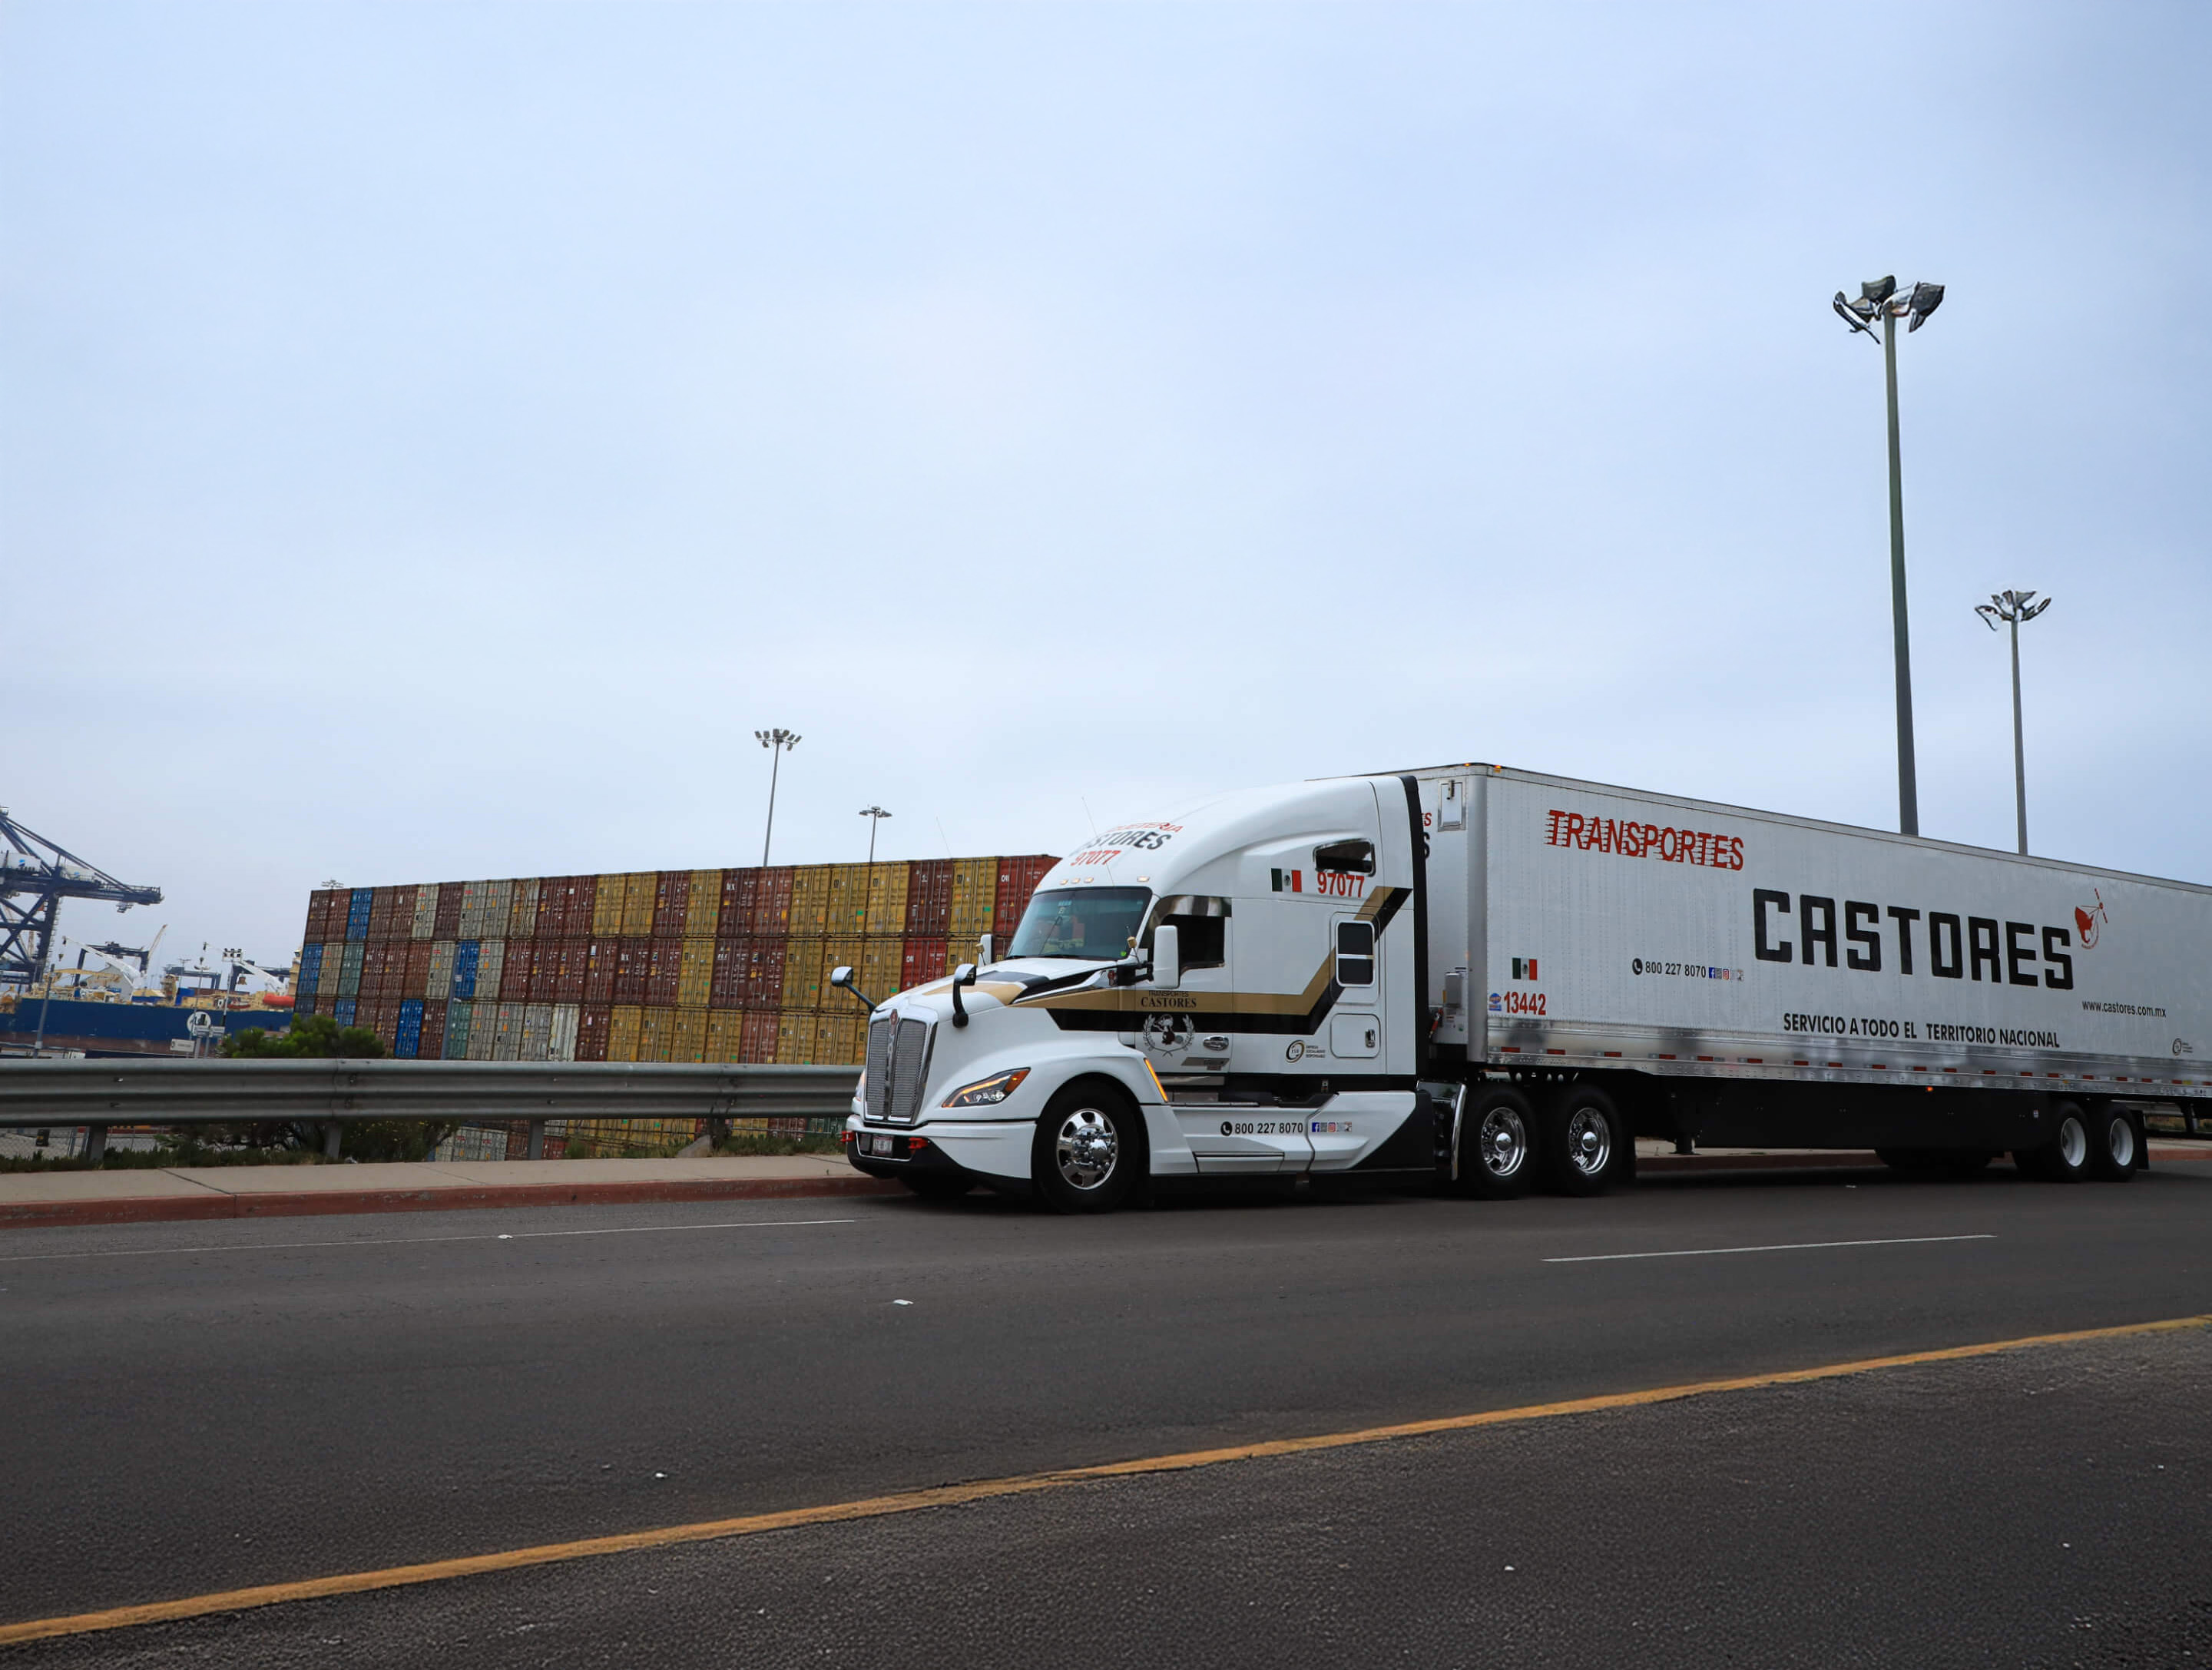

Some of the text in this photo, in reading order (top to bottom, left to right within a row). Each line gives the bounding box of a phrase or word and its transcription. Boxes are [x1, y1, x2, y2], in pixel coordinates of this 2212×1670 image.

[1071, 830, 1172, 854] STORES
[1544, 809, 1744, 871] TRANSPORTES
[1070, 850, 1122, 866] 97077
[1316, 870, 1365, 898] 97077
[1752, 887, 2074, 990] CASTORES
[1645, 961, 1706, 978] 800 227 8070
[1141, 996, 1197, 1008] CASTORES
[1504, 991, 1546, 1016] 13442
[2081, 1000, 2167, 1018] www.castores.com.mx
[1783, 1012, 2060, 1048] SERVICIO A TODO EL TERRITORIO NACIONAL
[1234, 1122, 1303, 1135] 800 227 8070
